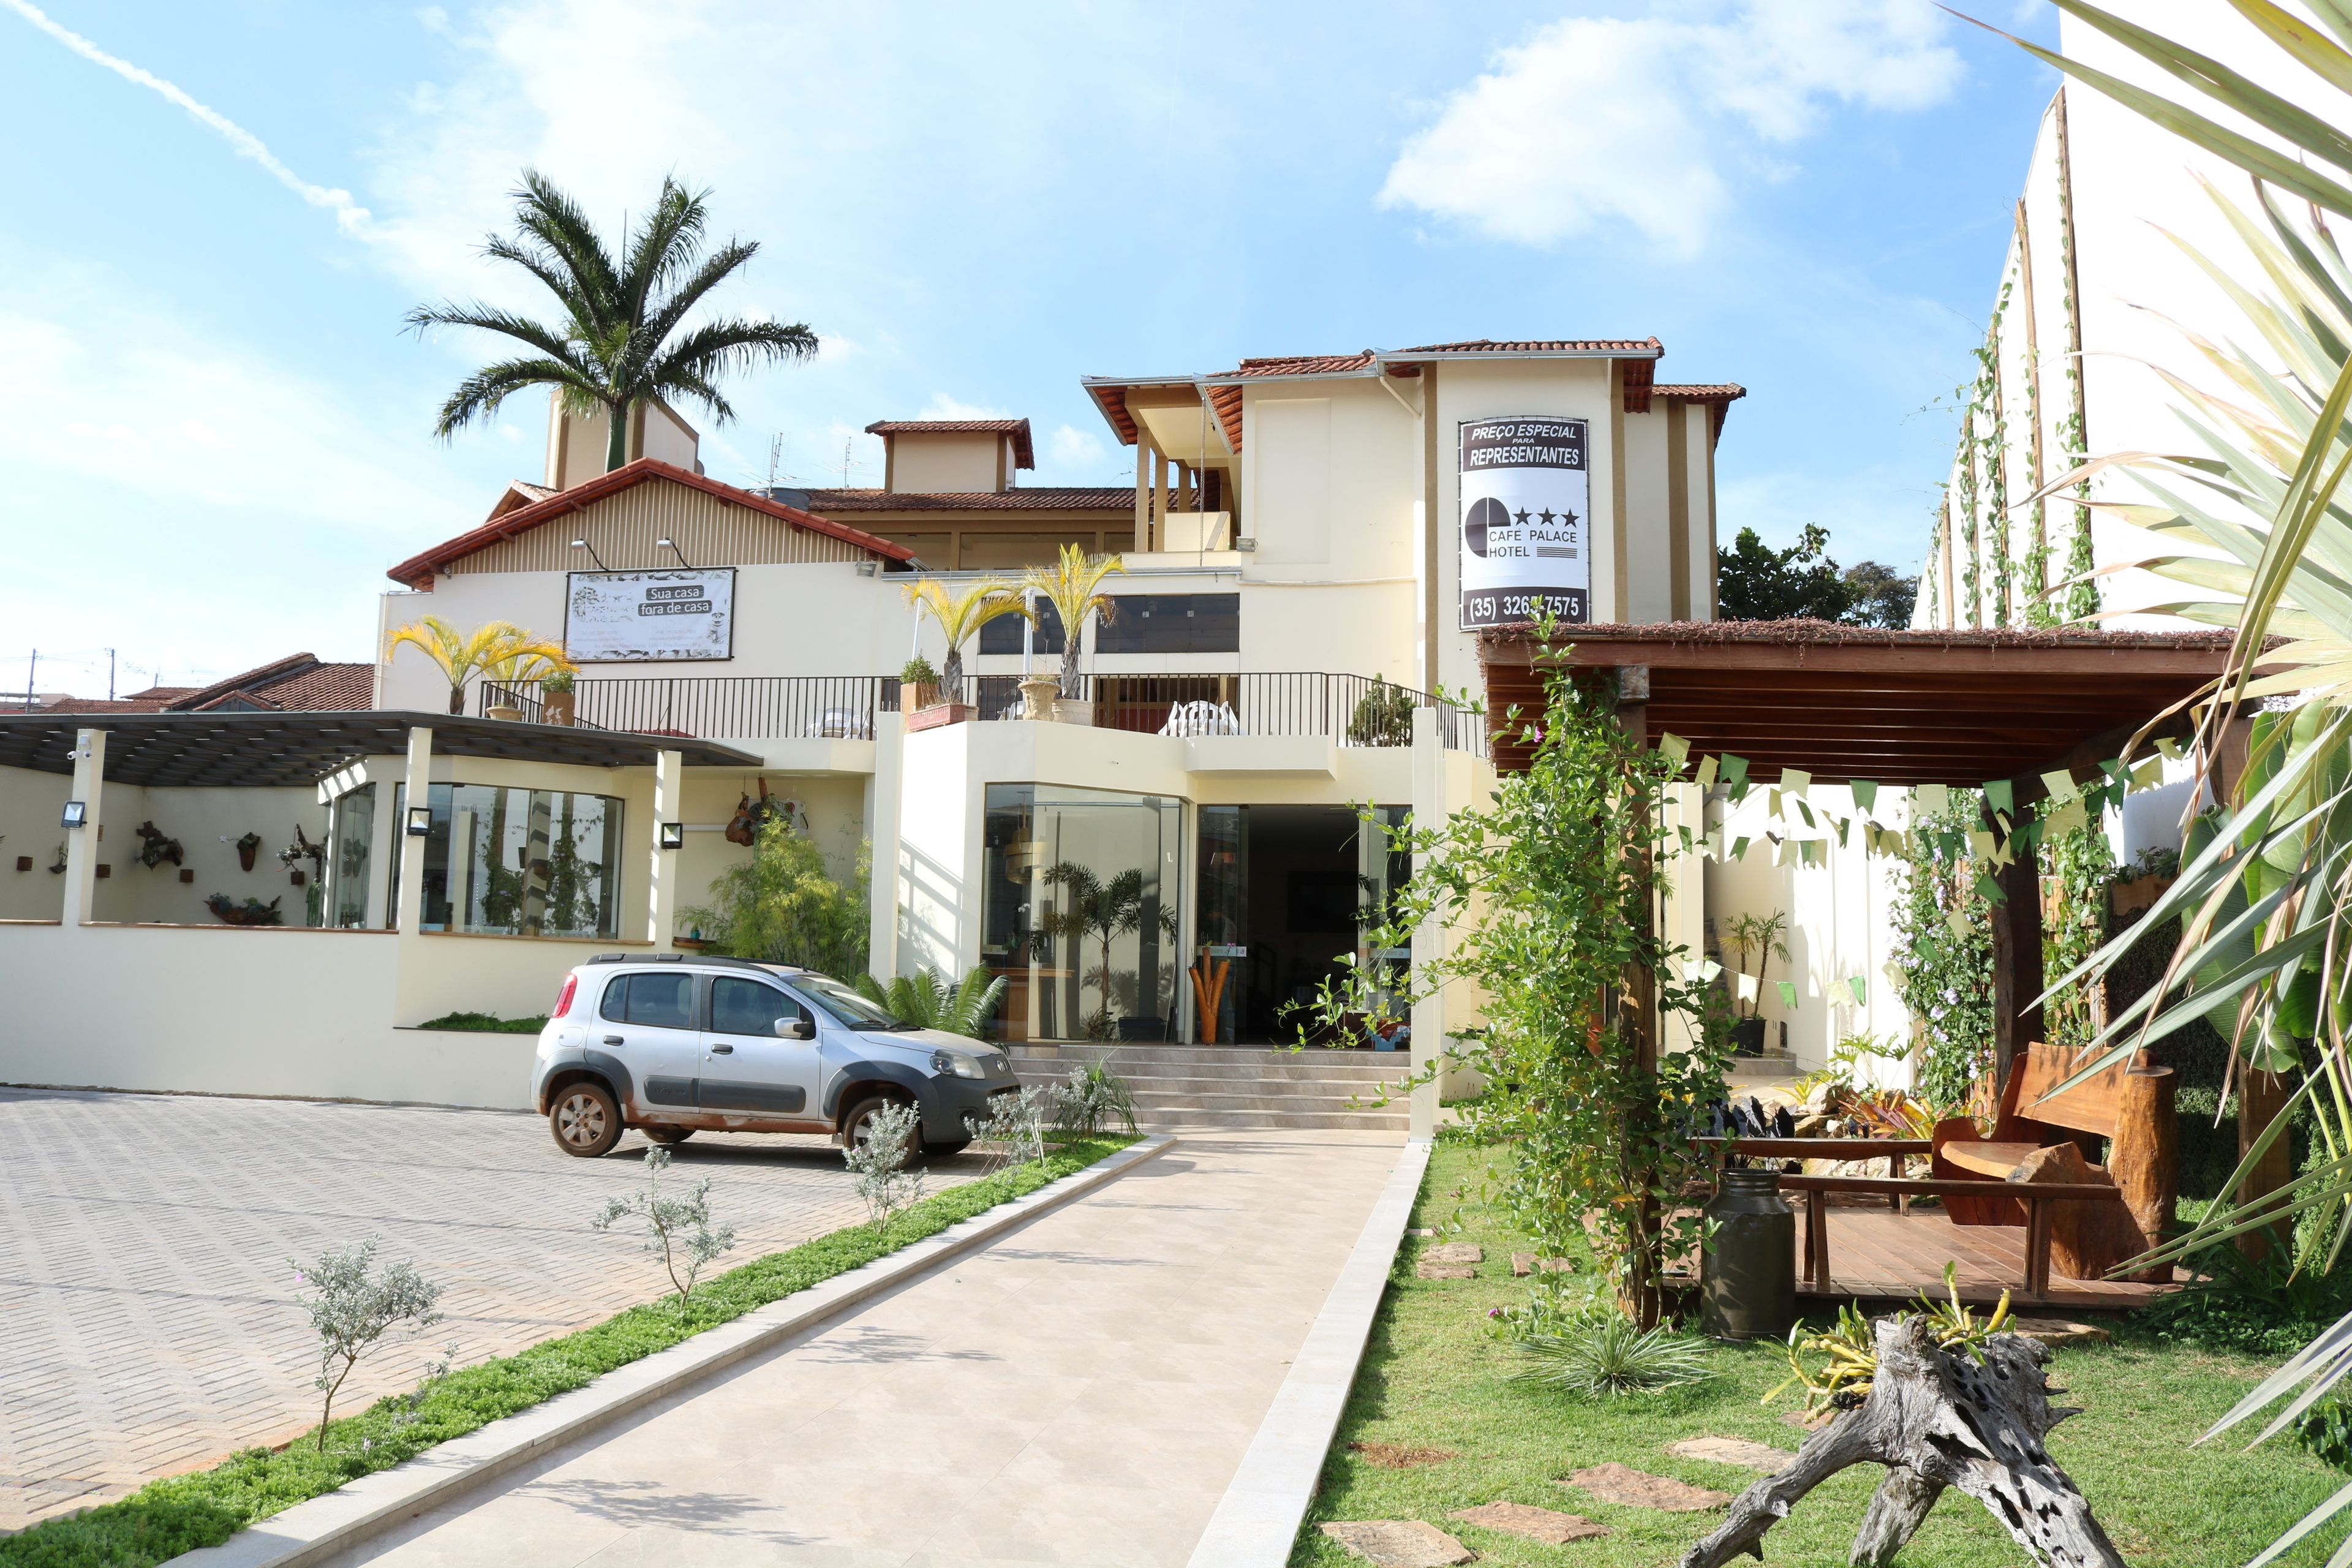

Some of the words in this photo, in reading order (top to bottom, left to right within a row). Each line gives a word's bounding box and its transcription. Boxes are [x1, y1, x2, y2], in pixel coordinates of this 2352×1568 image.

[1471, 425, 1515, 440] PREÇO
[1517, 424, 1577, 439] ESPECIAL
[1470, 447, 1579, 466] REPRESENTANTES
[1490, 529, 1521, 542] CAFÉ
[1530, 530, 1577, 543] PALACE
[1490, 546, 1530, 558] HOTEL
[650, 589, 671, 600] Sua
[674, 588, 699, 598] casa
[641, 604, 664, 615] fora
[667, 602, 681, 613] de
[684, 602, 709, 612] casa
[1470, 597, 1496, 622] (35)
